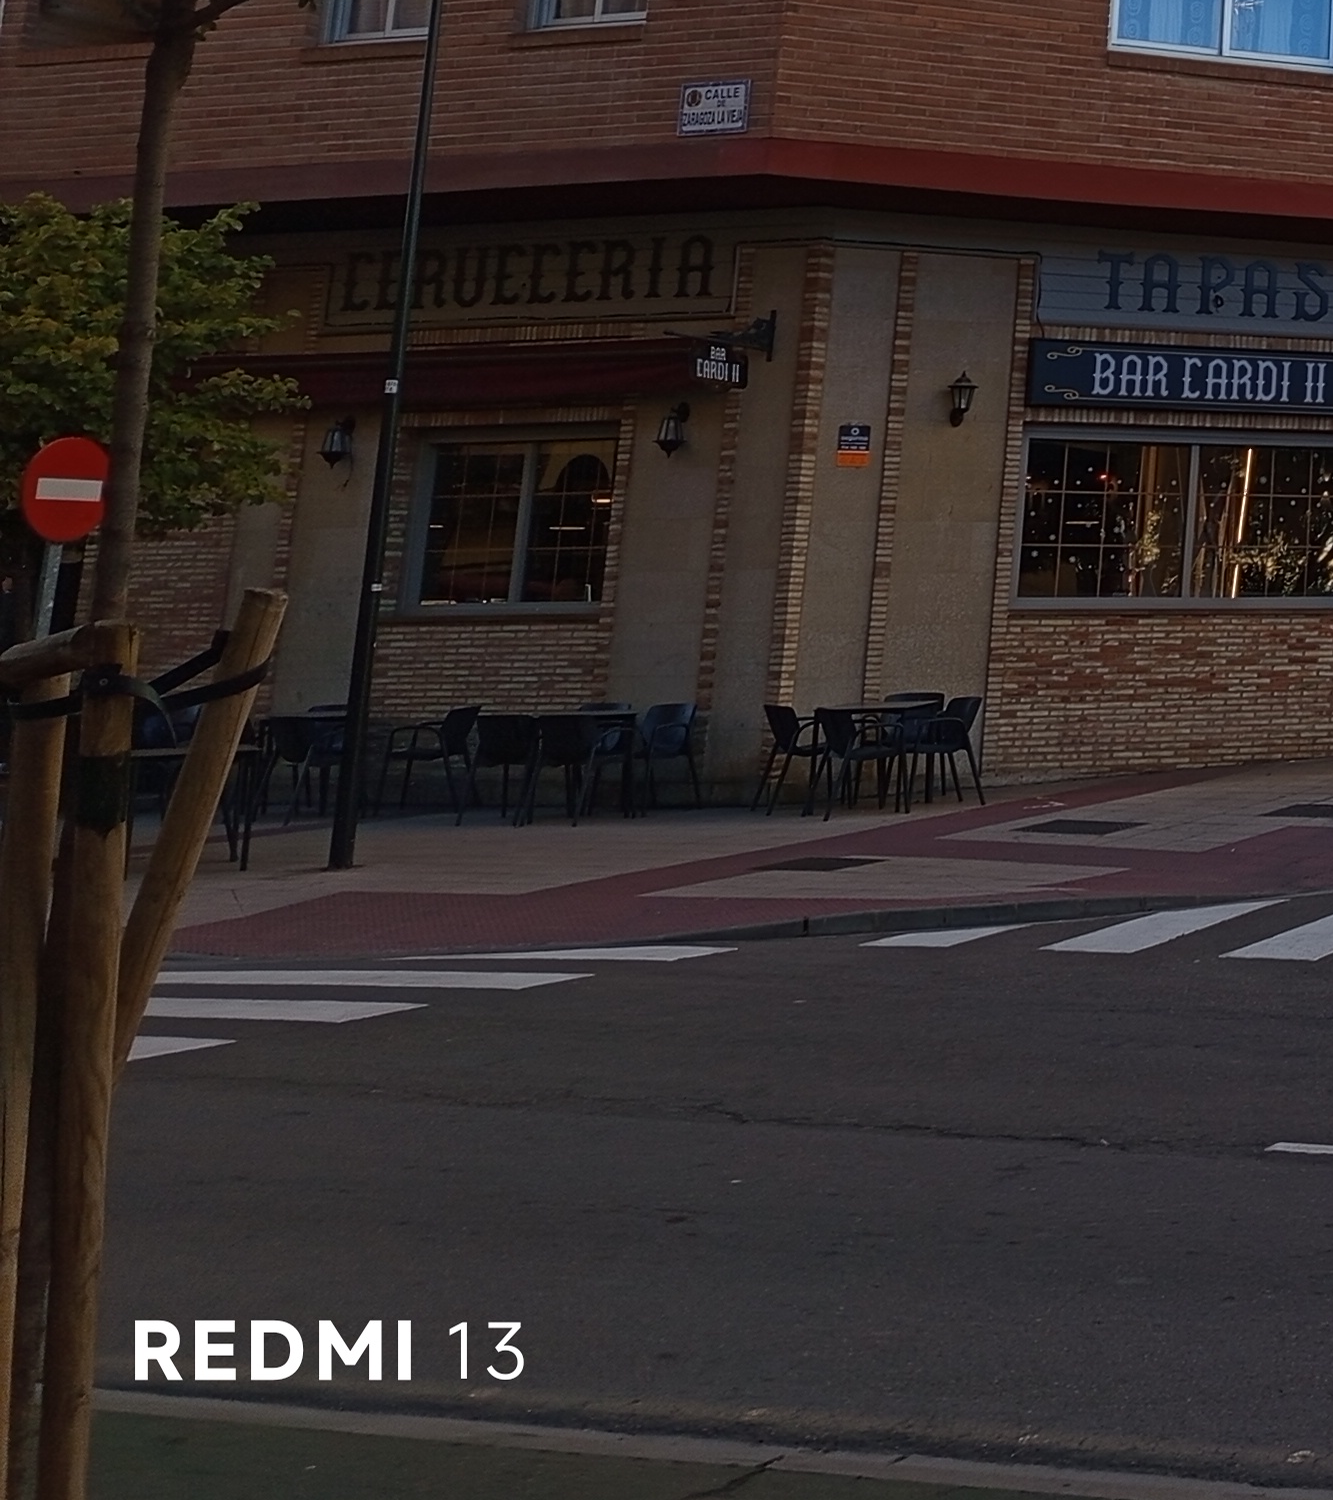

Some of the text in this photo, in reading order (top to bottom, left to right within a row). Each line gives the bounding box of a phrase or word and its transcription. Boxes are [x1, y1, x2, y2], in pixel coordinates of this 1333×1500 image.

[704, 86, 740, 101] CALLE
[1098, 251, 1329, 322] TAPAS
[711, 346, 726, 361] BAR
[696, 358, 729, 382] CARDI
[1092, 353, 1327, 403] BAR CARDI II
